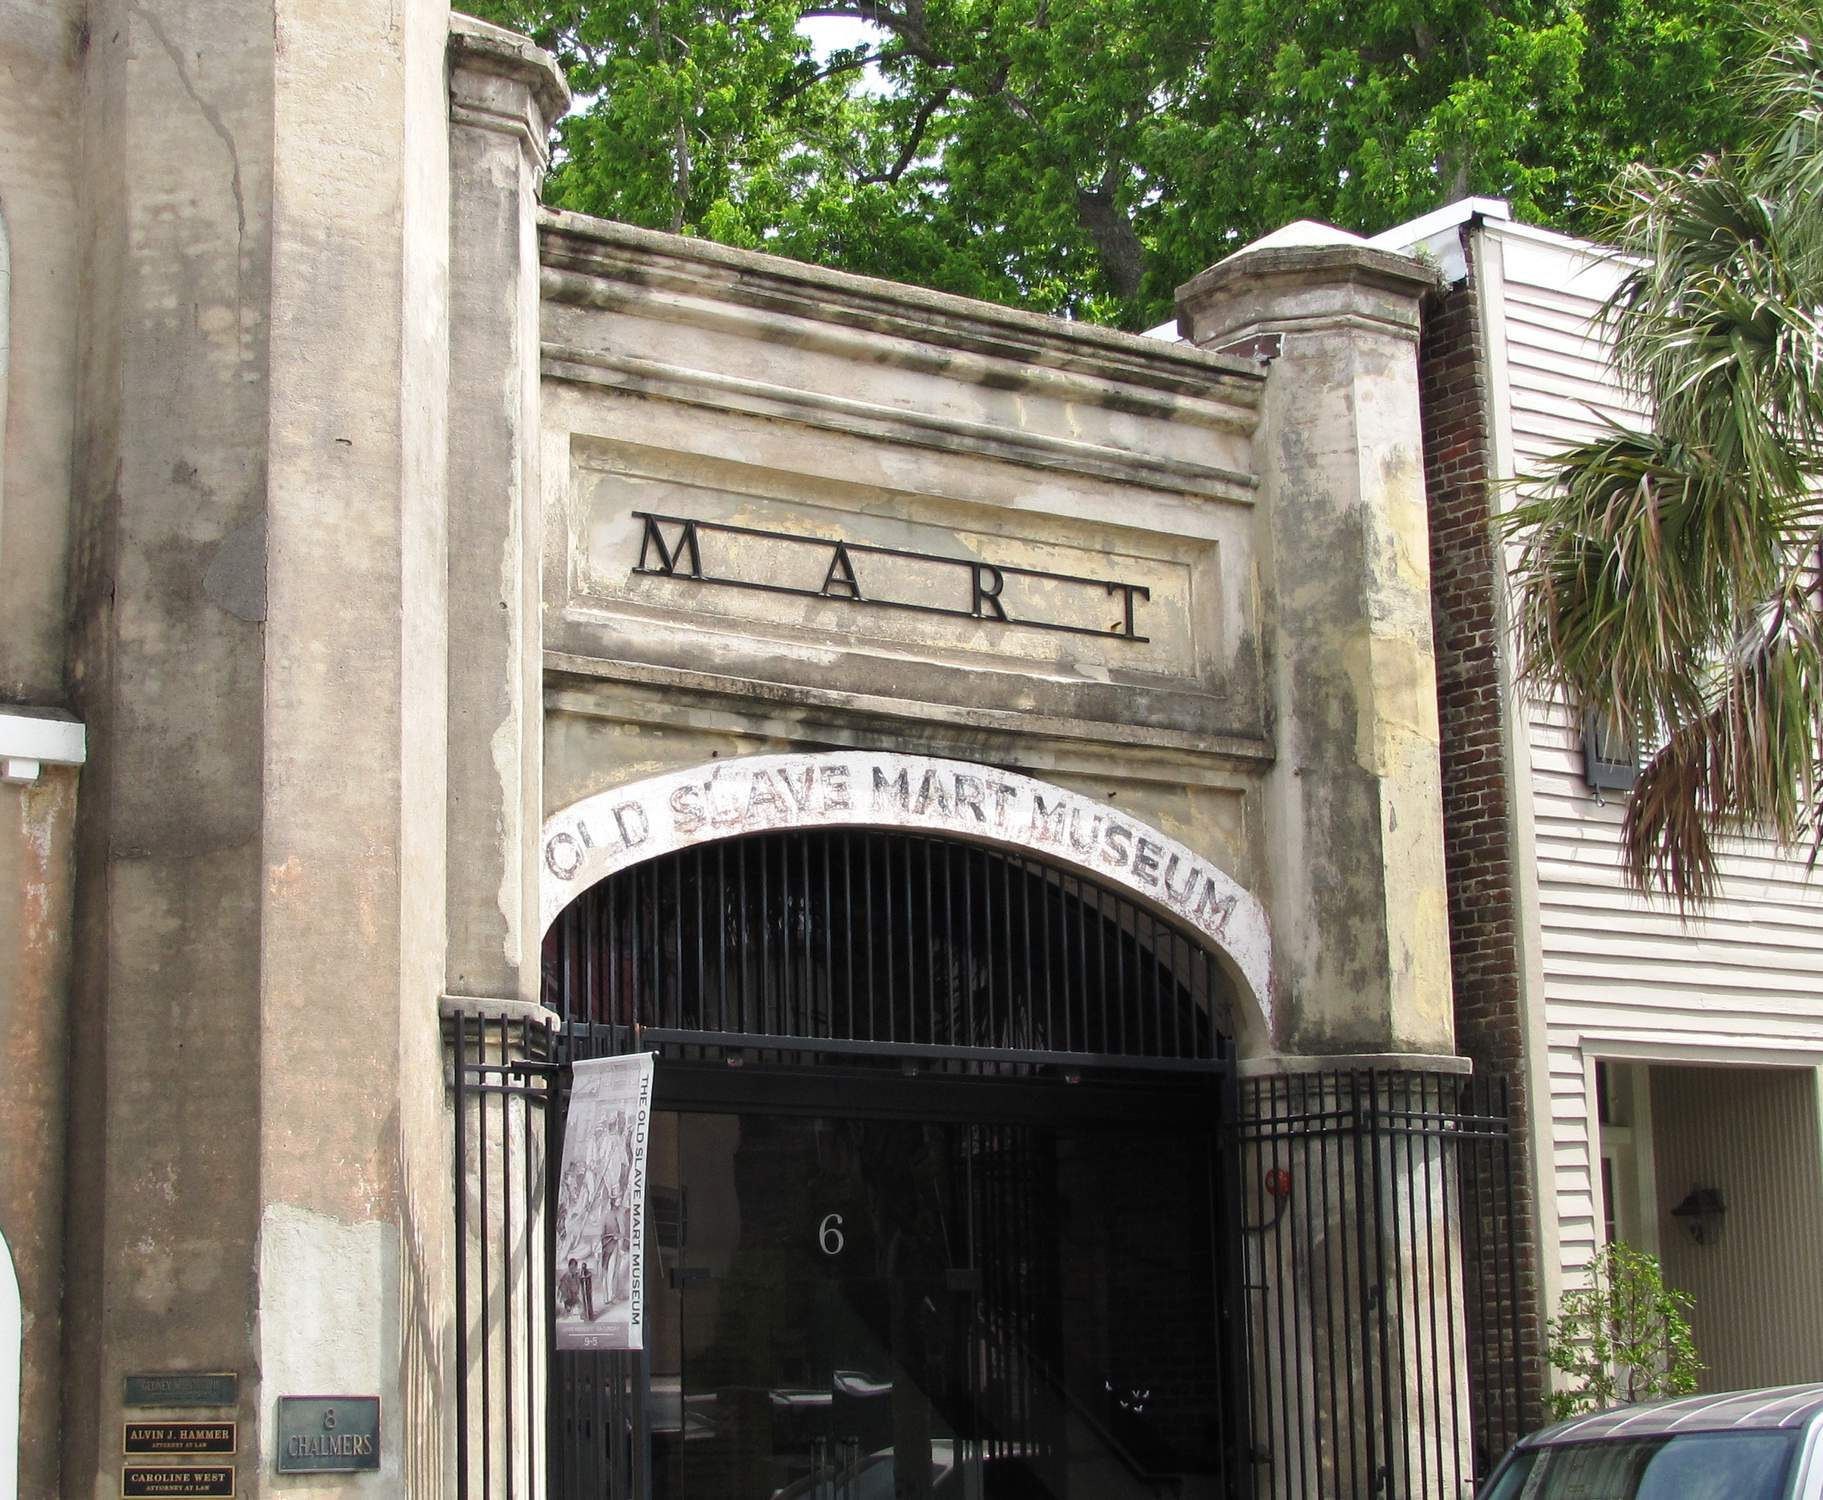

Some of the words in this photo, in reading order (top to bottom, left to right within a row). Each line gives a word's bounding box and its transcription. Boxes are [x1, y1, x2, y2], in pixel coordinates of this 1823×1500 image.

[632, 511, 1151, 643] MART
[544, 799, 650, 881] OLD
[669, 762, 856, 834] SLAVE
[871, 765, 1017, 827] MART
[1031, 793, 1239, 944] MUSEUM
[640, 1074, 649, 1107] THE
[635, 1110, 647, 1143] OLD
[632, 1146, 645, 1200] SLAVE
[631, 1203, 642, 1250] MART
[819, 1213, 844, 1255] 6
[631, 1253, 641, 1325] MUSEUM
[130, 1430, 165, 1440] ALVIN
[167, 1430, 177, 1440] J.
[180, 1429, 229, 1440] HAMMER
[324, 1407, 337, 1429] 8
[288, 1434, 373, 1457] CHALMERS
[131, 1473, 191, 1482] CAROLINE
[194, 1473, 226, 1482] WEST
[146, 1484, 183, 1492] ATTORNEY
